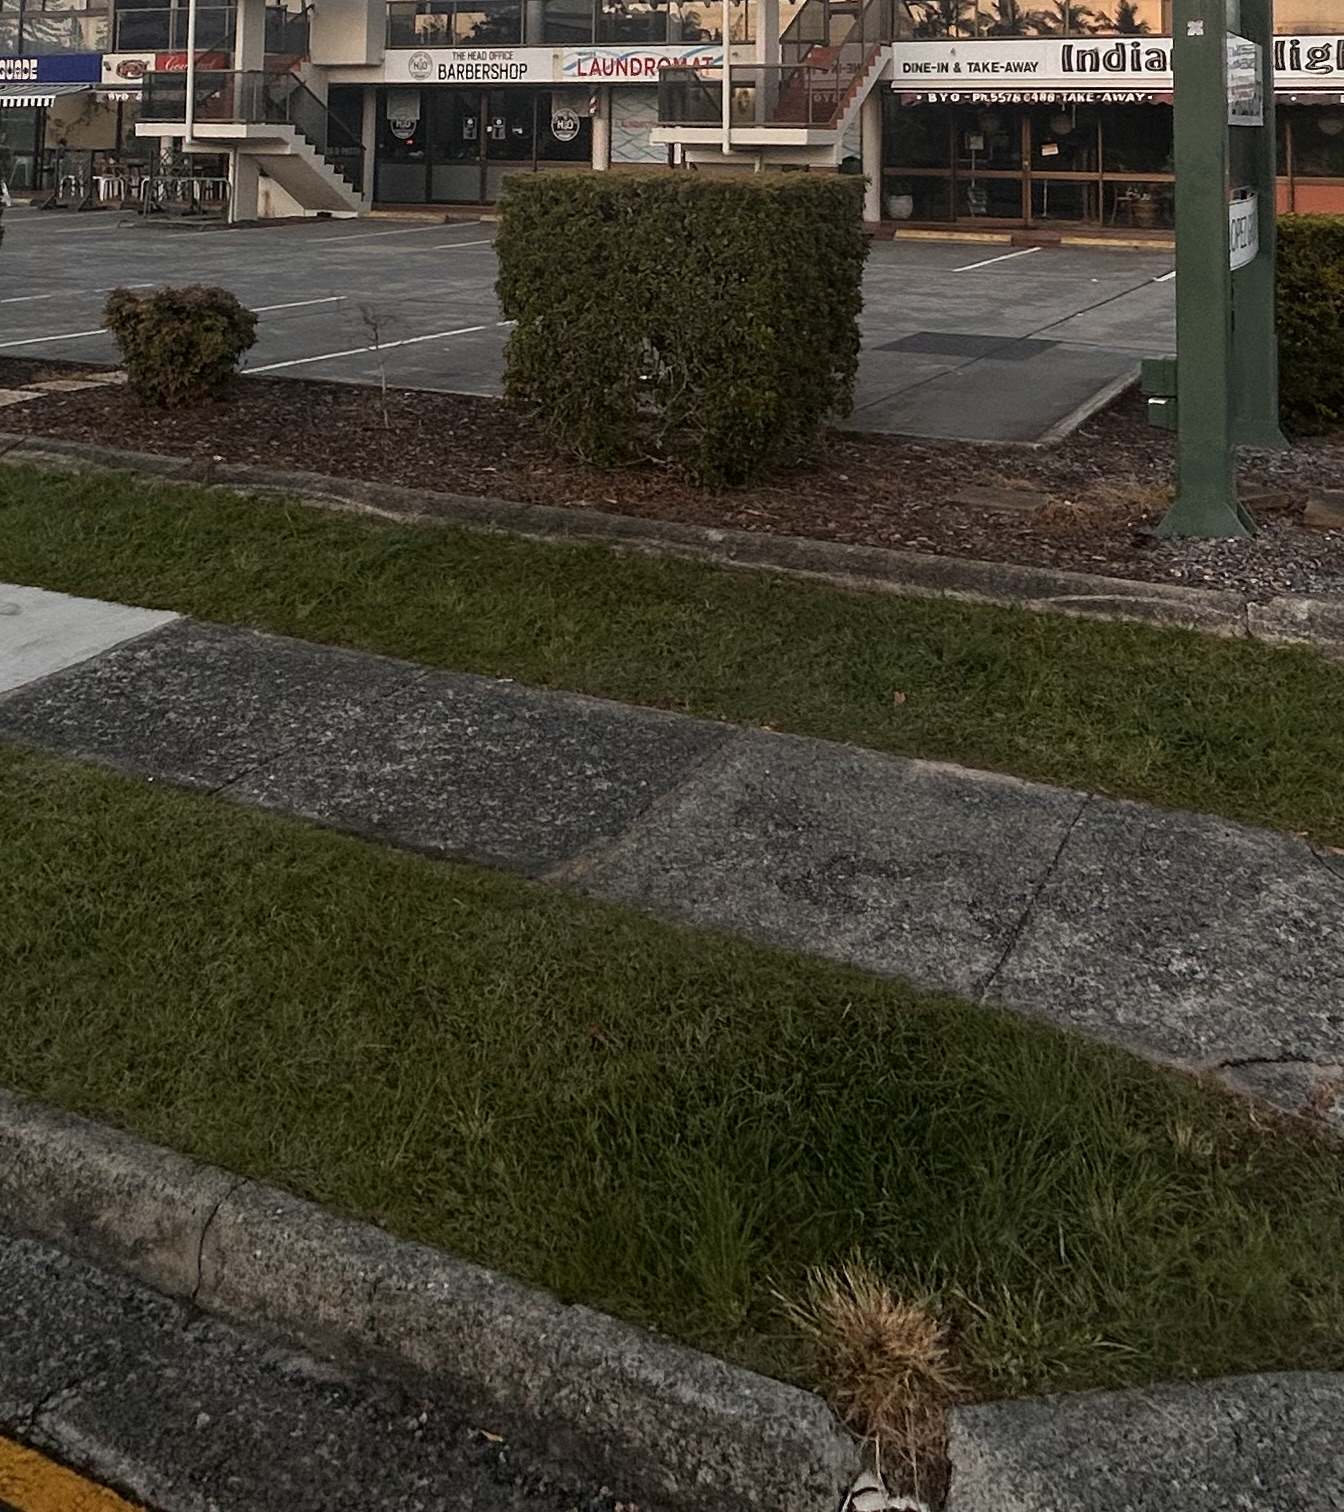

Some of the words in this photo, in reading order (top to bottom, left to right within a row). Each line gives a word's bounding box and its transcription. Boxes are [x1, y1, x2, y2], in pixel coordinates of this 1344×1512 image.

[452, 51, 466, 61] THE
[467, 51, 487, 61] HEAD
[488, 50, 514, 61] OFFICE
[1061, 41, 1173, 72] India
[438, 63, 528, 81] BARBERSHOP
[902, 62, 949, 73] DINE-IN
[953, 62, 962, 73] &
[967, 61, 1039, 73] TAKE-AWAY
